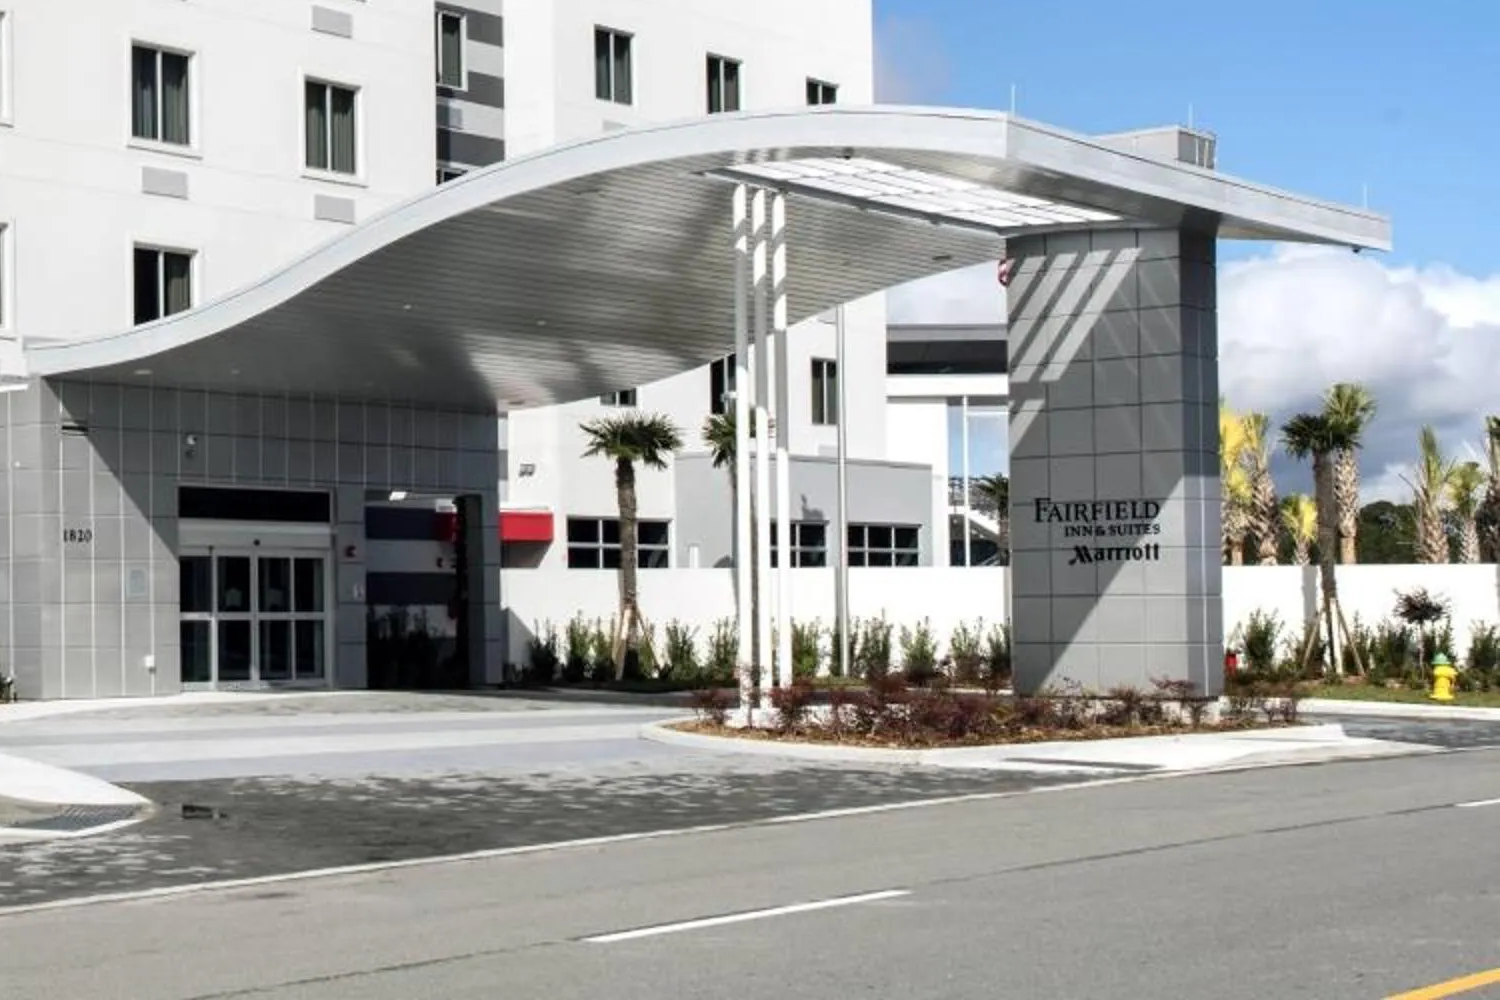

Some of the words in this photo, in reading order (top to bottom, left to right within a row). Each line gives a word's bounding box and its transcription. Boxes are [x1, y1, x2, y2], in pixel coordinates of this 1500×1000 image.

[1034, 498, 1161, 523] FAIRFIELD
[1108, 523, 1161, 536] SUITES
[1068, 543, 1160, 566] Marriott
